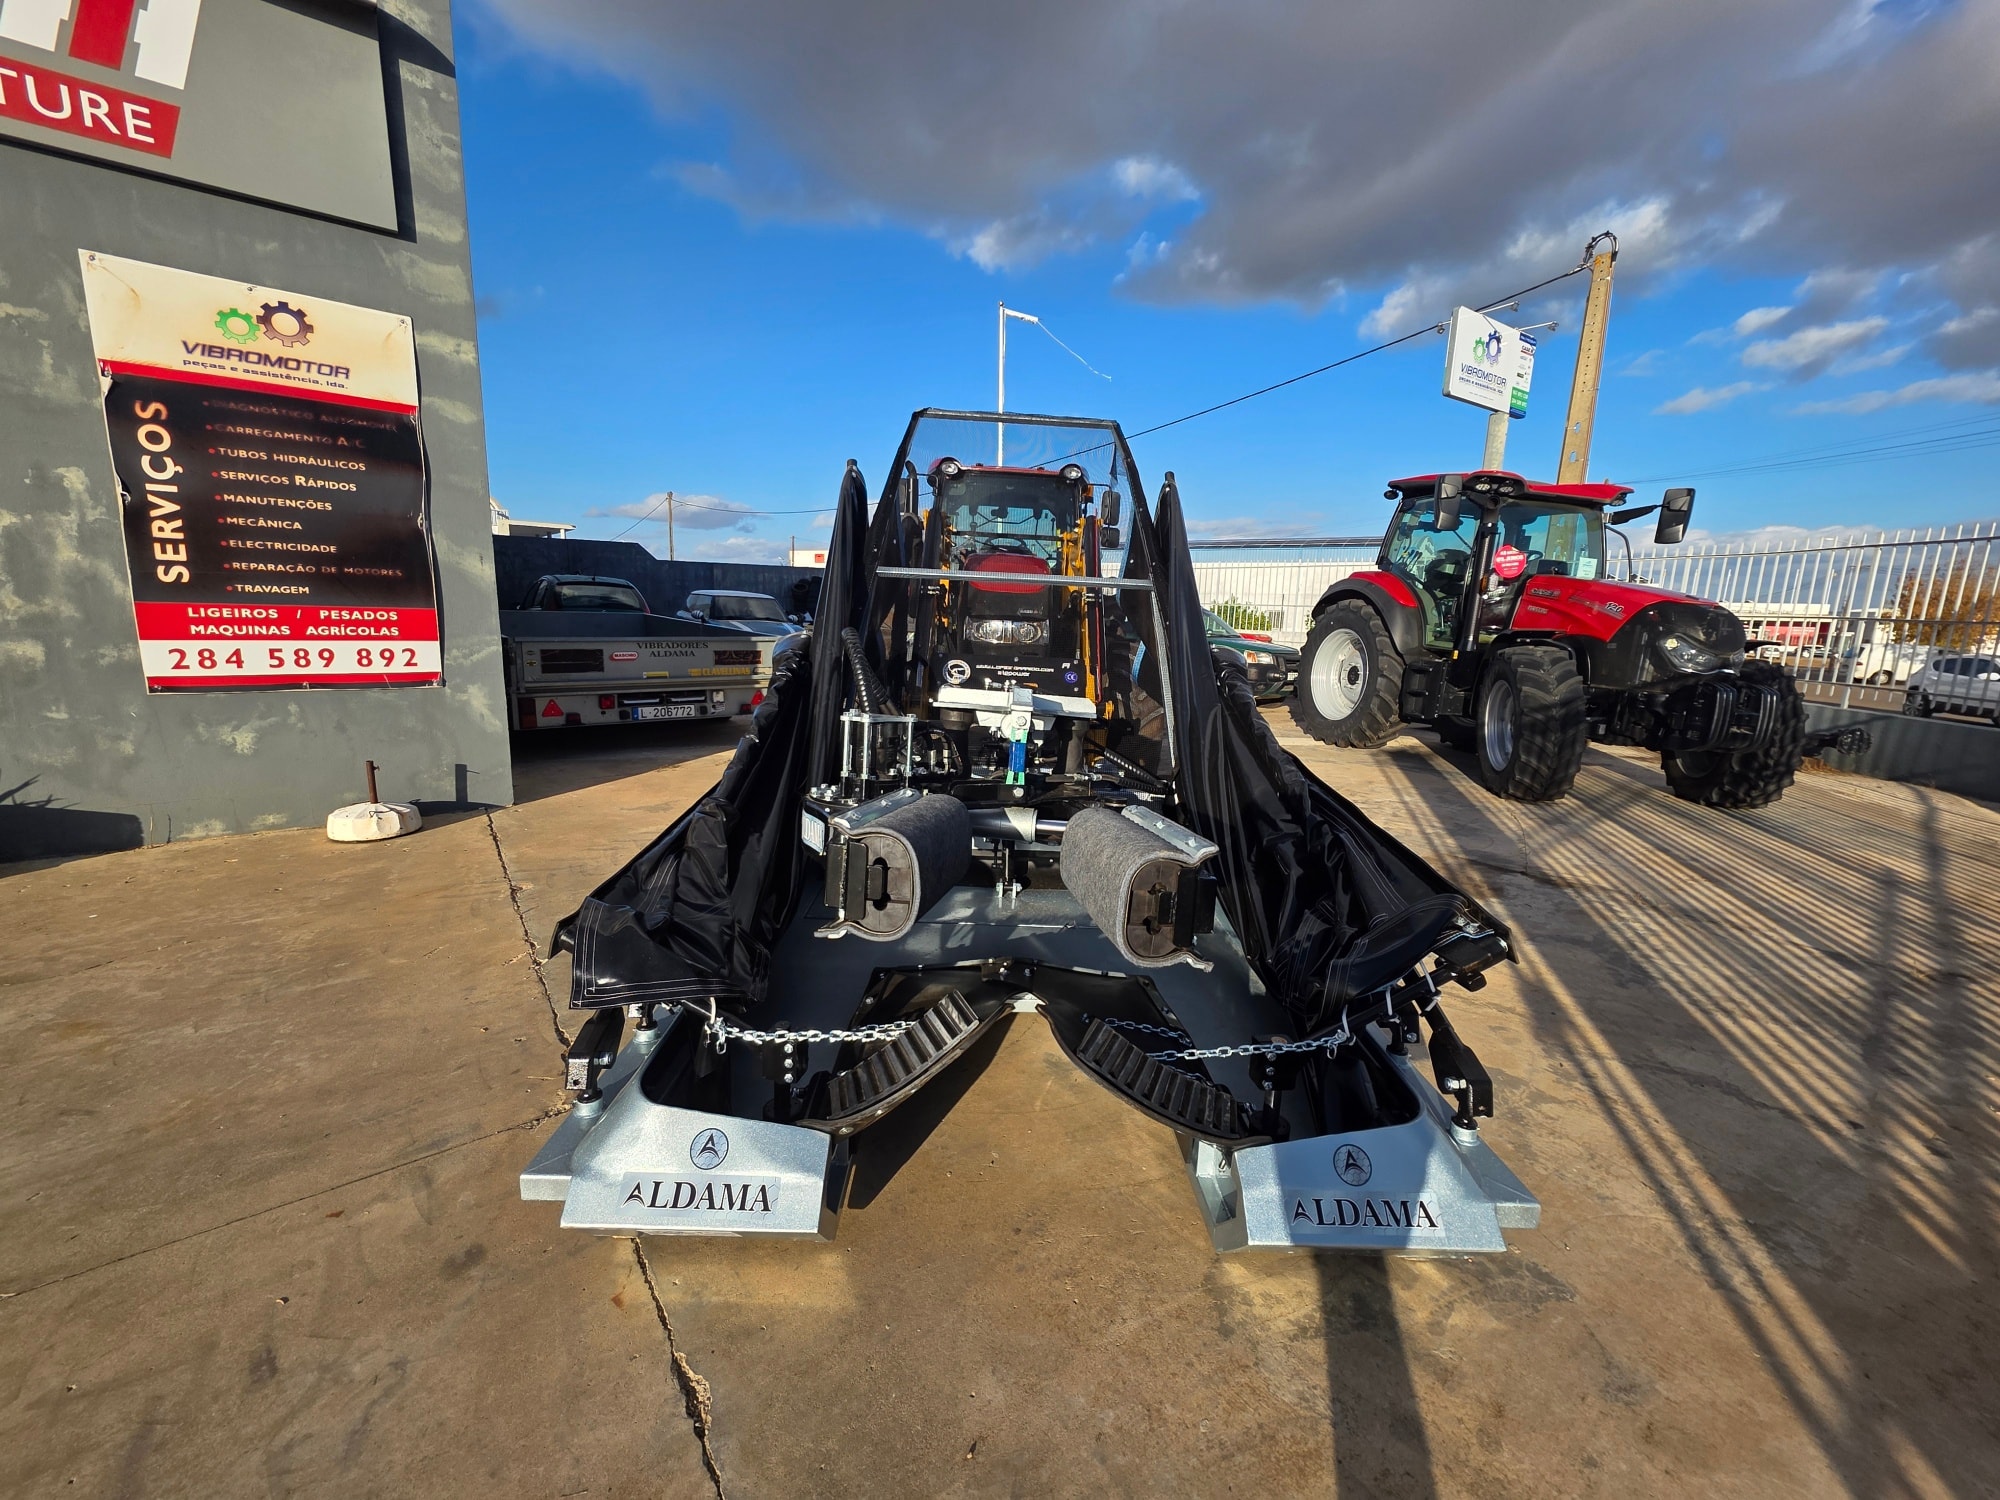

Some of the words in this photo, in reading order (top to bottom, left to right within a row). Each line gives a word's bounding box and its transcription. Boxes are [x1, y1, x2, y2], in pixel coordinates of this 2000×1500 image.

[181, 340, 351, 379] VIBROMOTOR
[183, 359, 226, 369] peças
[1461, 362, 1507, 386] VIBROMOTOR
[215, 424, 332, 444] CARREGAMENTO
[218, 447, 268, 460] TUBOS
[273, 453, 366, 471] HIDRÁULICOS
[220, 470, 289, 485] SERVIÇOS
[295, 474, 357, 491] RÁPIDOS
[134, 400, 190, 584] SERVIÇOS
[223, 494, 333, 511] MANUTENÇÕES
[226, 516, 303, 530] MECÂNICA
[229, 540, 337, 553] ELECTRICIDADE
[232, 562, 316, 574] REPARAÇÃO
[321, 566, 338, 574] DE
[344, 567, 403, 577] MOTORES
[235, 584, 310, 595] TRAVAGEM
[187, 607, 279, 619] LIGEIROS
[296, 609, 302, 619] /
[320, 610, 398, 620] PESADOS
[190, 625, 291, 637] MAQUINAS
[306, 623, 400, 636] AGRÍCOLAS
[168, 648, 245, 670] 284
[268, 648, 335, 669] 589
[356, 648, 418, 668] 892
[650, 650, 696, 658] ALDAMA
[621, 1180, 773, 1212] ALDAMA
[1292, 1198, 1440, 1229] ALDAMA
